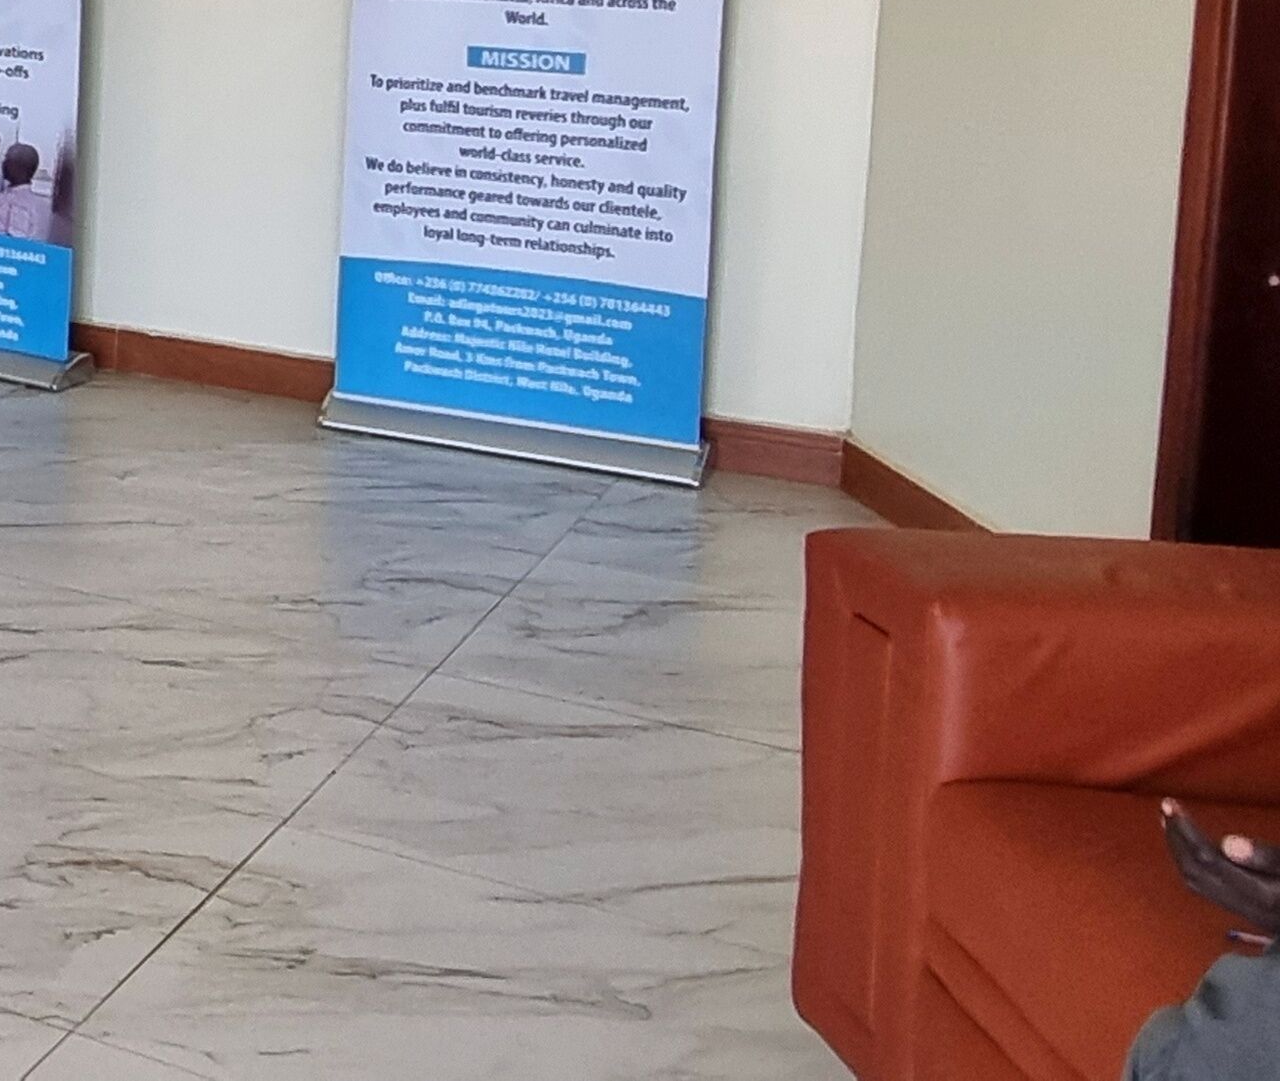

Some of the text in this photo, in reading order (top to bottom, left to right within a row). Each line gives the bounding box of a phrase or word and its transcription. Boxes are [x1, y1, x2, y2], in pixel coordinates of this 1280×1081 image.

[505, 10, 548, 26] World.
[481, 50, 570, 70] MISSION
[371, 74, 383, 88] To
[386, 77, 444, 94] prioritize
[447, 81, 470, 94] and
[474, 82, 546, 99] benchmark
[550, 88, 588, 102] travel
[400, 99, 427, 112] plus
[463, 103, 512, 119] tourism
[516, 109, 567, 123] reveries
[571, 111, 625, 131] through
[629, 118, 652, 129] our
[403, 122, 647, 152] commitment to offering personalized
[459, 146, 585, 168] world-class service.
[366, 156, 384, 171] We
[388, 159, 402, 173] do
[406, 161, 451, 177] believe
[455, 164, 467, 178] in
[551, 174, 604, 194] honesty
[608, 180, 633, 194] and
[638, 184, 686, 203] quality
[385, 180, 465, 199] performance
[469, 189, 513, 205] geared
[517, 193, 569, 209] towards
[573, 201, 594, 212] our
[374, 201, 673, 243] employees and community can culminate into
[424, 225, 453, 241] loyal
[457, 228, 522, 248] long-term
